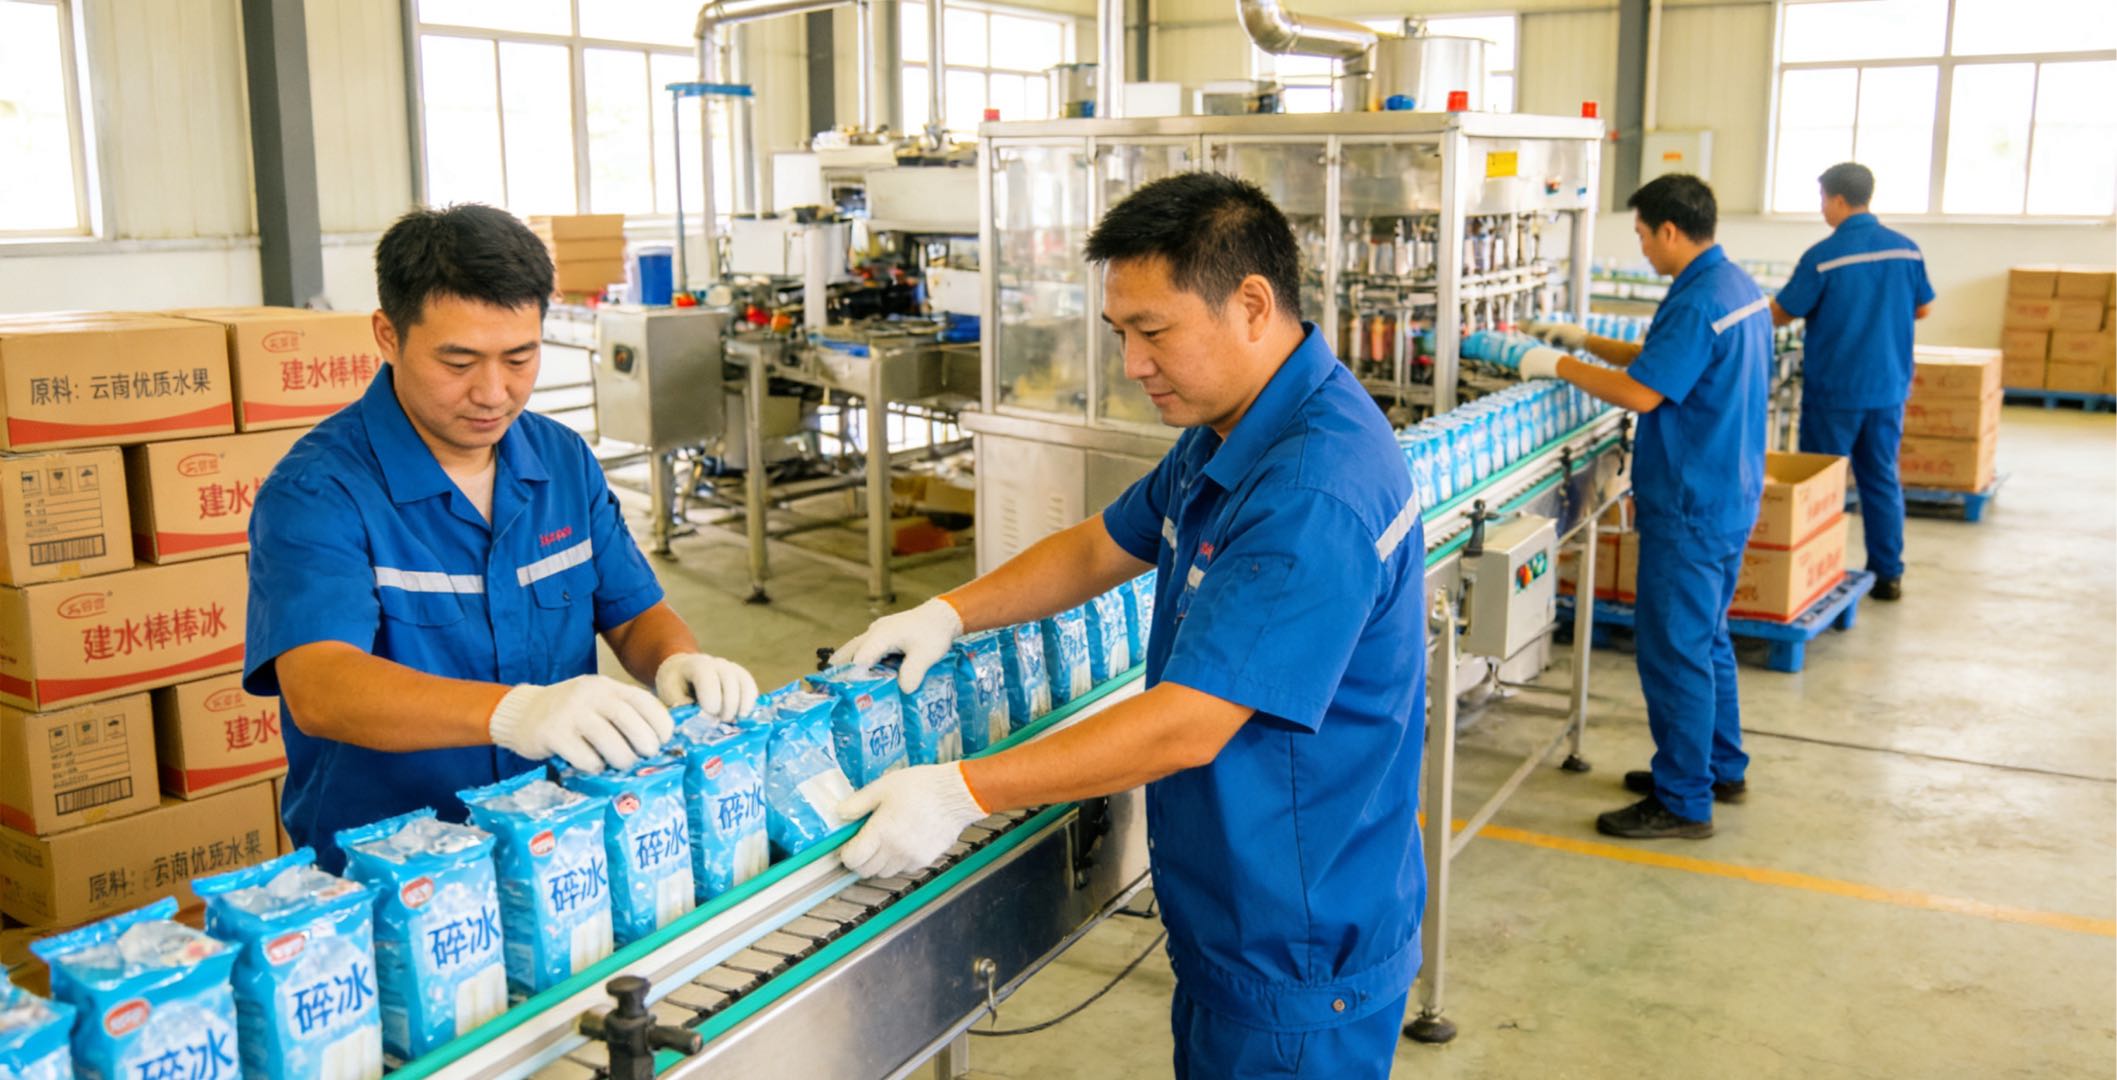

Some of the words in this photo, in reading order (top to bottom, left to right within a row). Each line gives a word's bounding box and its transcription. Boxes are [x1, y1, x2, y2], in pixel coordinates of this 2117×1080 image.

[280, 352, 382, 392] 建水棒棒
[198, 478, 265, 520] 建水
[81, 600, 228, 664] 建水棒棒冰
[718, 782, 766, 831] 碎冰
[635, 815, 688, 870] 碎冰
[548, 855, 608, 916] 碎冰
[427, 904, 502, 971] 碎冰
[290, 962, 375, 1036] 碎冰
